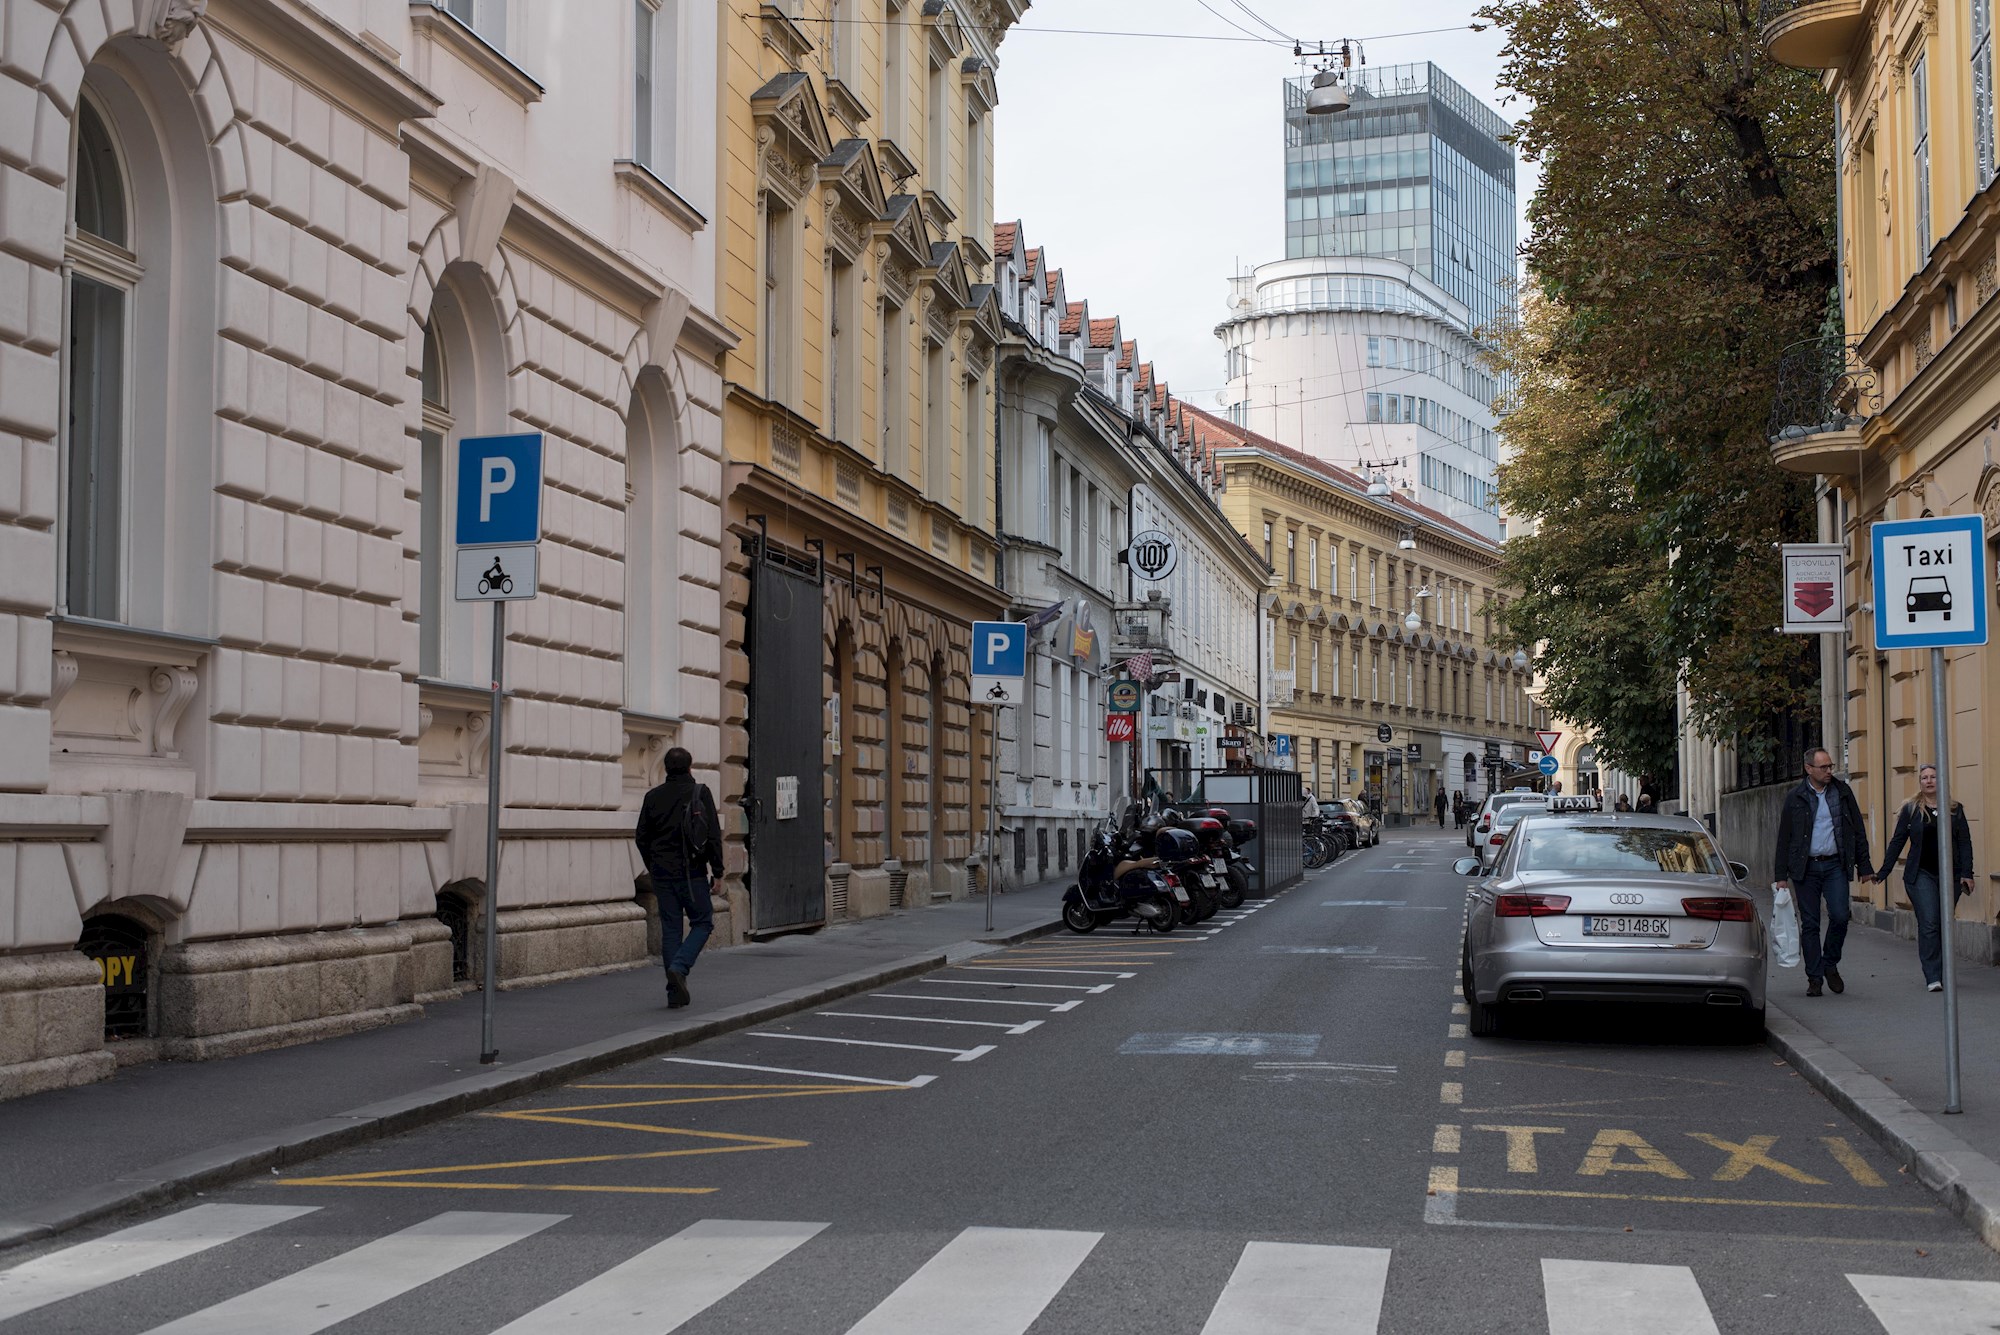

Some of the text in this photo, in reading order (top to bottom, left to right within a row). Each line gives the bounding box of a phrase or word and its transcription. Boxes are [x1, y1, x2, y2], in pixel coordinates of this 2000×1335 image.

[480, 456, 516, 522] P
[1142, 545, 1163, 566] 101
[1791, 559, 1836, 567] EUROVILLA
[1903, 543, 1953, 567] Taxi
[987, 632, 1010, 665] P
[1108, 718, 1132, 739] illy
[1280, 738, 1286, 752] P
[1554, 797, 1590, 809] TAXI
[1593, 918, 1609, 932] ZG
[1472, 1124, 1888, 1188] TAXI
